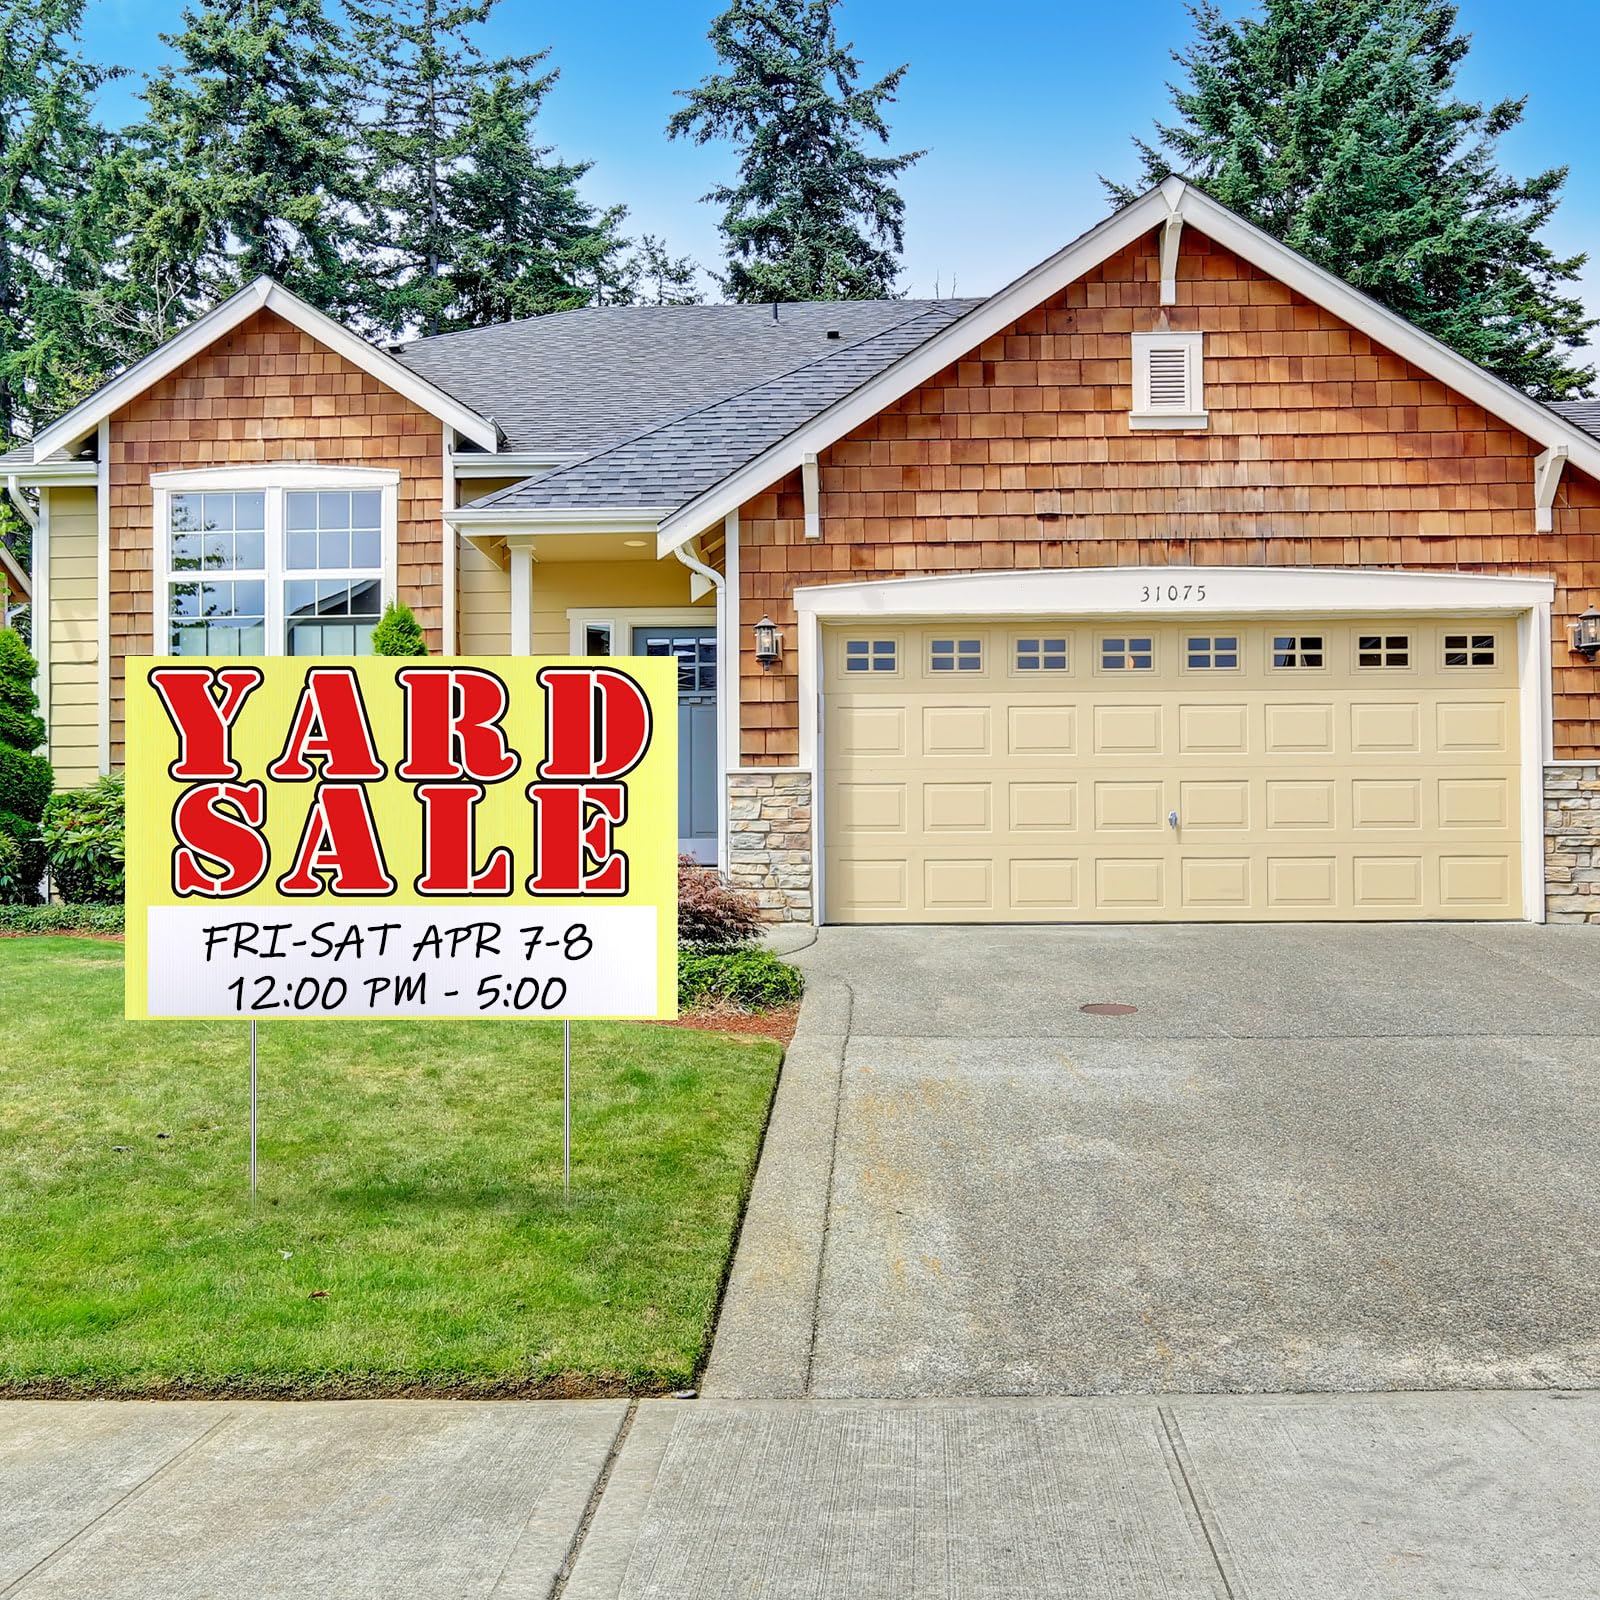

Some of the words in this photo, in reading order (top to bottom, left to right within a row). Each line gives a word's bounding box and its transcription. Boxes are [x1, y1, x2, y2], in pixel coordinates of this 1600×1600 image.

[1140, 585, 1206, 603] 31075
[147, 666, 654, 783] YARD
[171, 780, 630, 899] SALE
[202, 921, 402, 962] FRI-SAT
[412, 922, 502, 962] APR
[519, 923, 593, 961] 7-8
[227, 976, 348, 1011] 12:00
[363, 972, 426, 1008] PM
[476, 974, 567, 1010] 5:00
